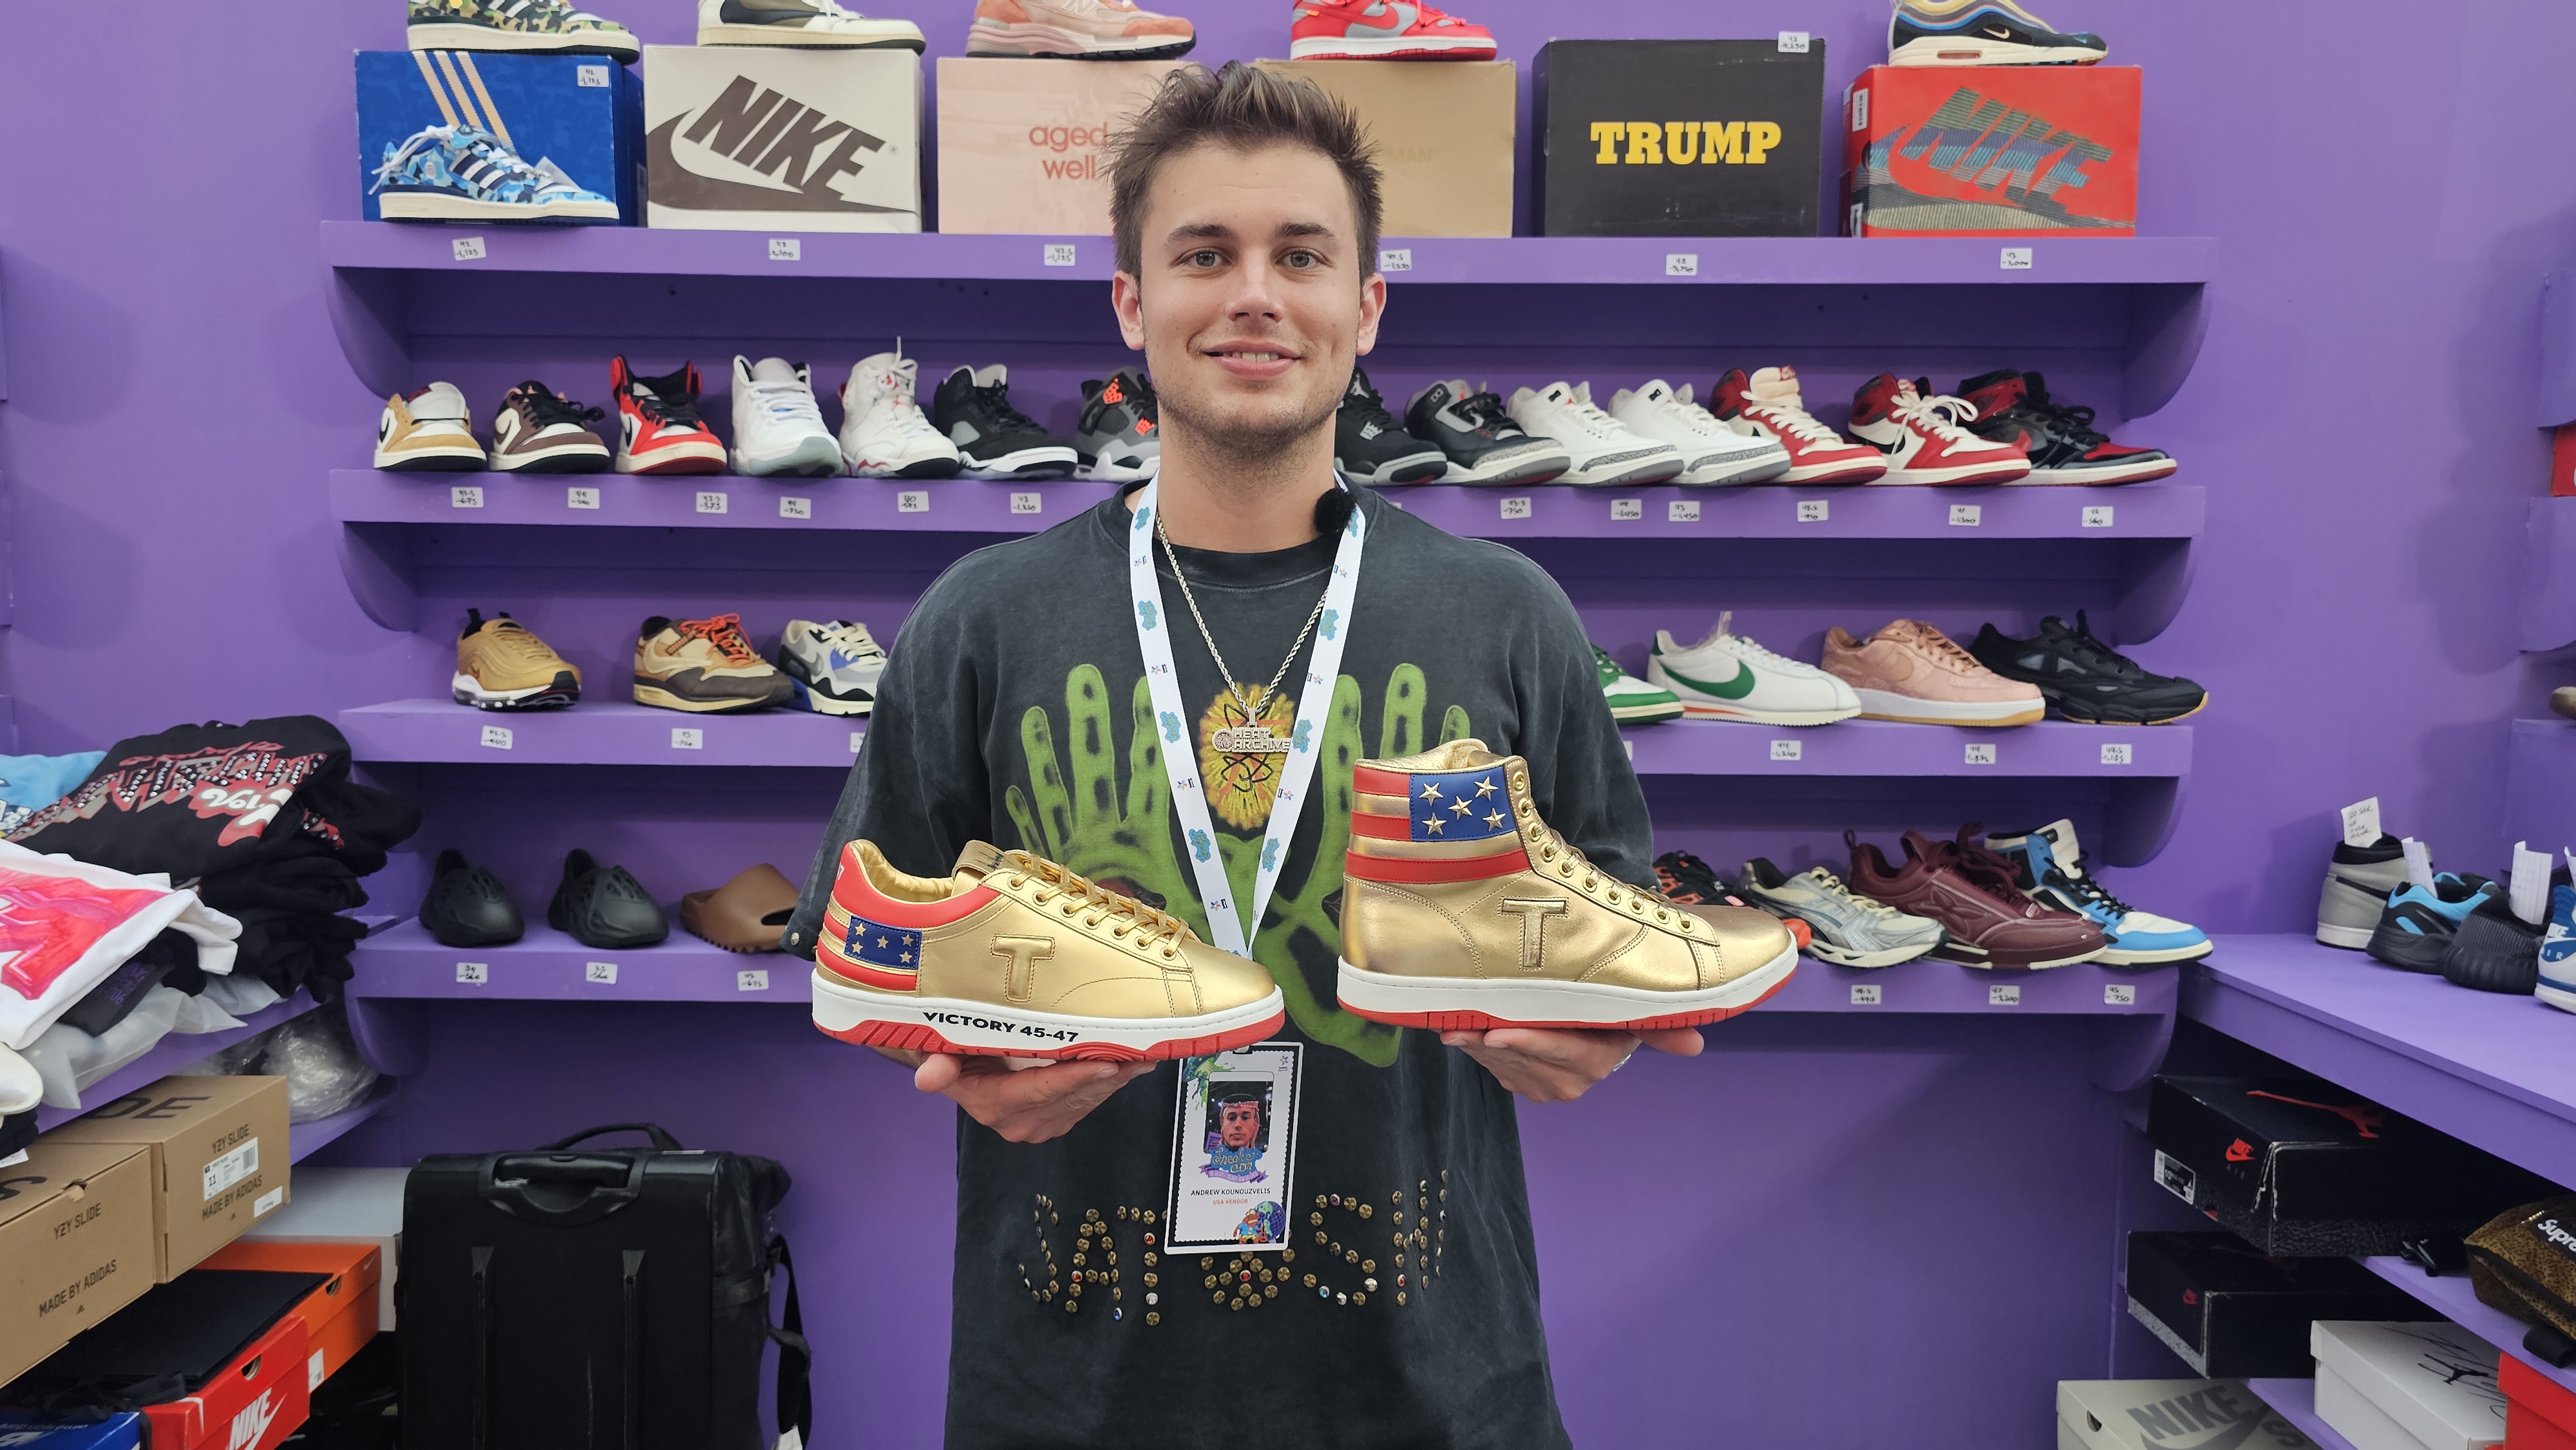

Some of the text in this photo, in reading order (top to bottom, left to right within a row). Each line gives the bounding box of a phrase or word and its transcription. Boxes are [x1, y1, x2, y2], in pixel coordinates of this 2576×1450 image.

[682, 74, 887, 197] NIKE
[1029, 121, 1108, 153] aged
[1590, 121, 1781, 165] TRUMP
[1899, 86, 2114, 209] NIKE
[1042, 155, 1097, 180] well
[1234, 730, 1269, 738] HEAT
[1234, 739, 1290, 749] ARCHIVE
[1502, 898, 1569, 970] T
[991, 934, 1055, 1003] T
[923, 1012, 1079, 1042] VICTORY 45-47
[212, 1124, 250, 1154] YZY SLIDE
[202, 1198, 223, 1221] MADE
[224, 1193, 234, 1207] BY
[236, 1174, 263, 1200] ADIDAS
[53, 1202, 101, 1239] YZY SLIDE
[2537, 1219, 2576, 1254] Supre
[39, 1259, 117, 1317] MADE BY ADIDAS
[229, 1387, 272, 1450] NIKE
[2127, 1384, 2253, 1440] NIKE
